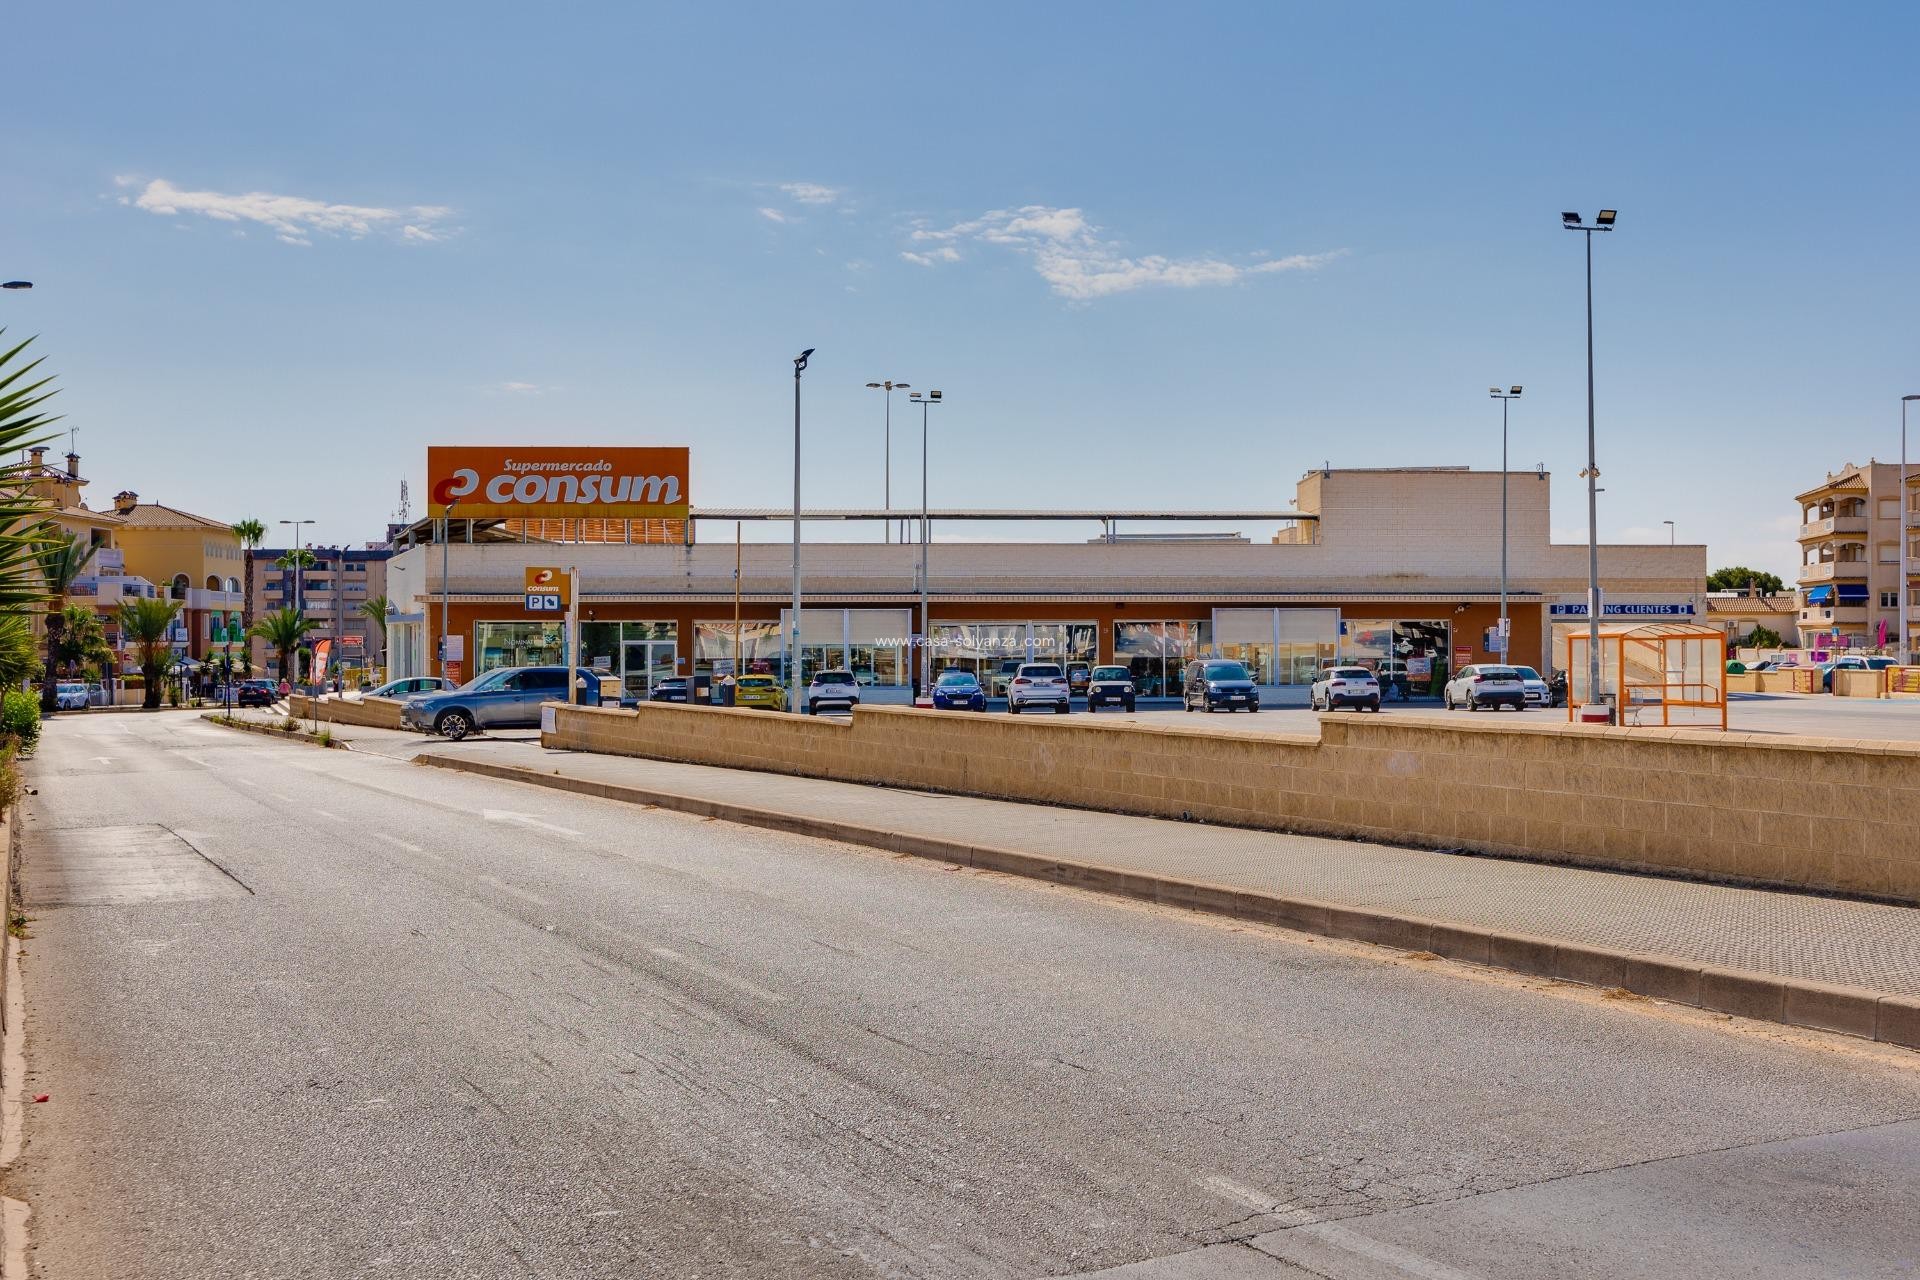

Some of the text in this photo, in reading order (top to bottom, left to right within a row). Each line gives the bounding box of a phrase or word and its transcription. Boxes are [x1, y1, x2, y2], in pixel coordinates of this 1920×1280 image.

[504, 459, 612, 474] Supermercado
[486, 475, 681, 504] consum
[1625, 606, 1672, 614] CLIENTES
